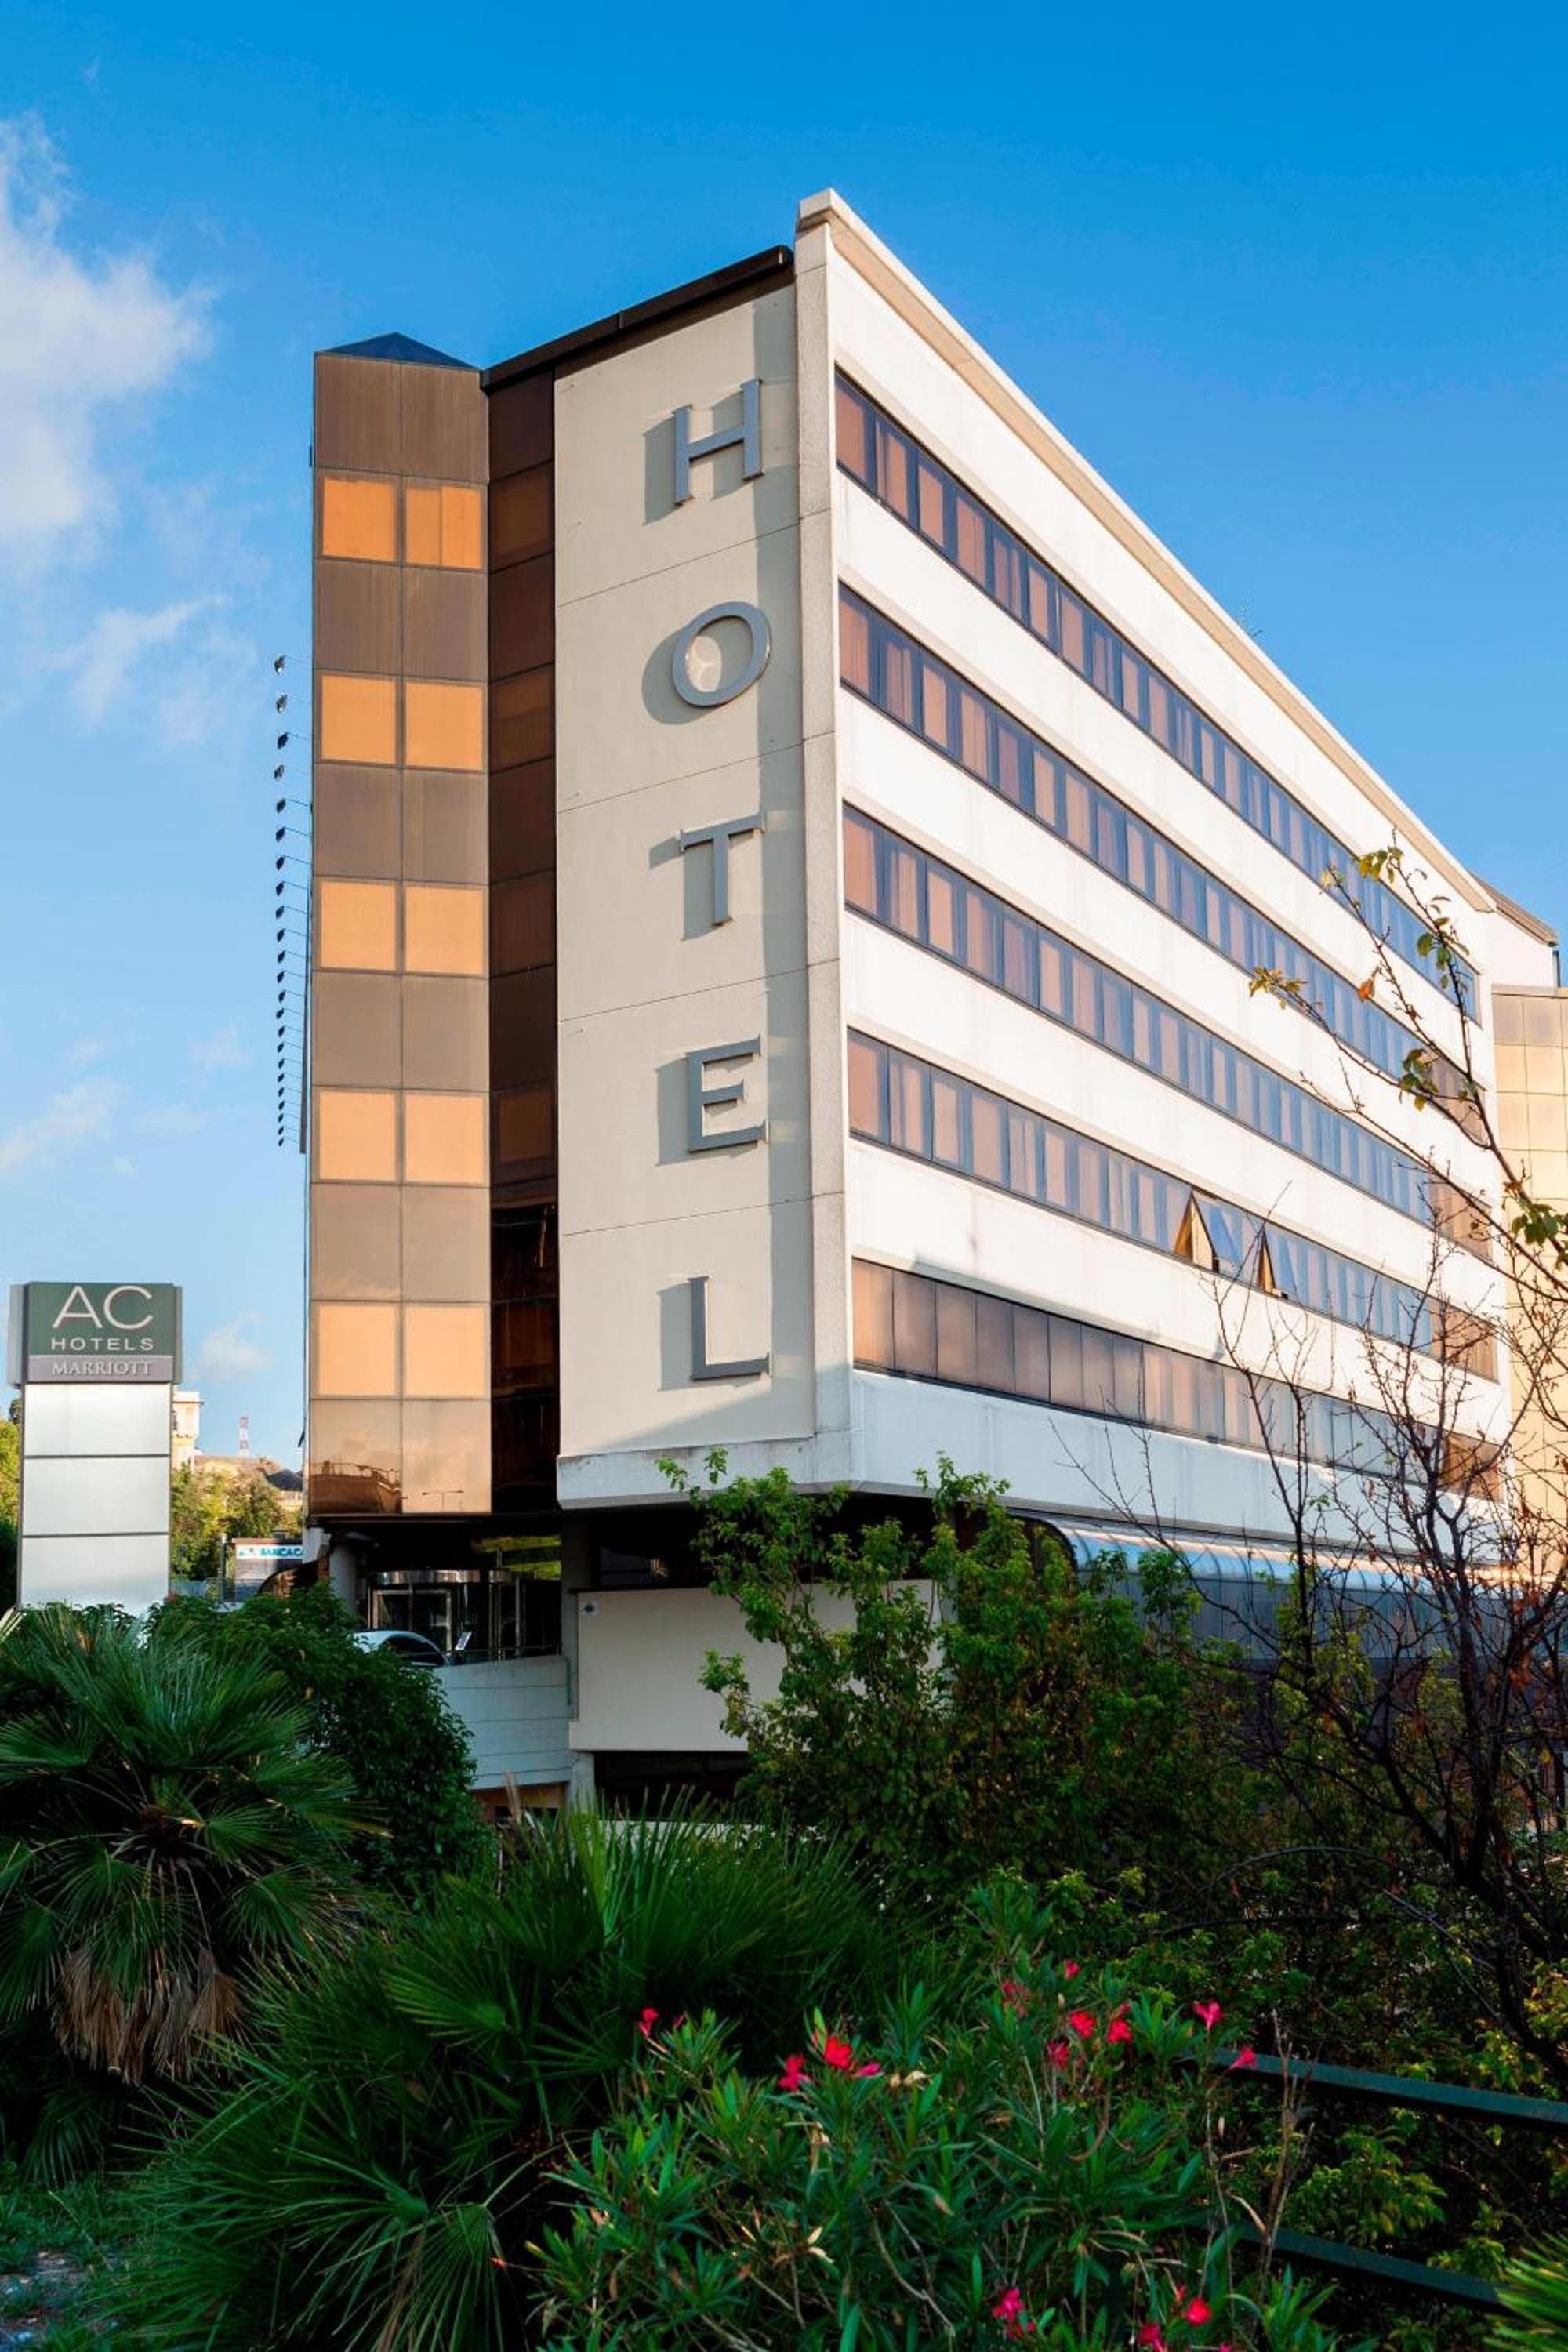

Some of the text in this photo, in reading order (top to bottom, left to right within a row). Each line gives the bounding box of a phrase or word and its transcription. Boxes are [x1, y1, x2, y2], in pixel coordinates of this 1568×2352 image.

[672, 376, 772, 1381] HOTEL
[53, 1285, 154, 1330] AC
[51, 1337, 154, 1351] HOTELS
[52, 1360, 151, 1375] MARRIOTT
